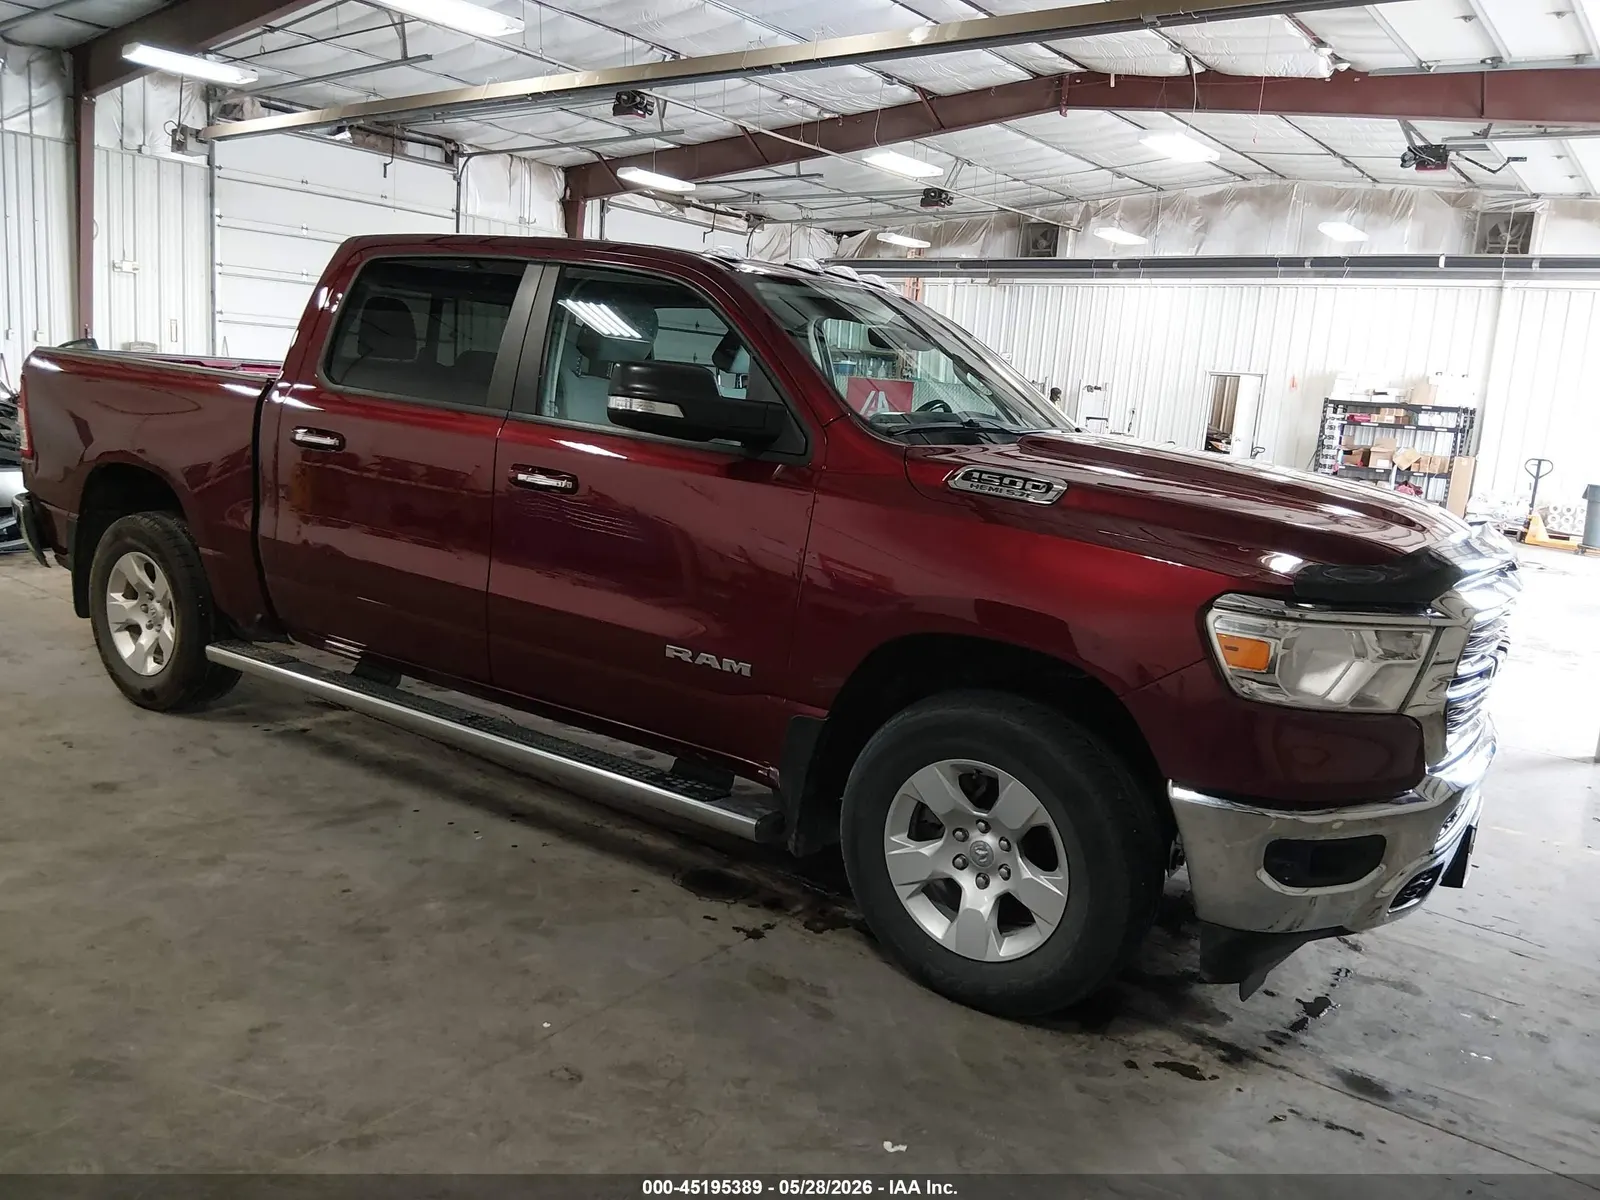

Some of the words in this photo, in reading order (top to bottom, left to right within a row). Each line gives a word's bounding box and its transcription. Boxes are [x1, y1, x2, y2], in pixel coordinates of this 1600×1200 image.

[963, 471, 1048, 493] 1500
[969, 483, 1003, 494] HEMI
[665, 644, 752, 677] RAM
